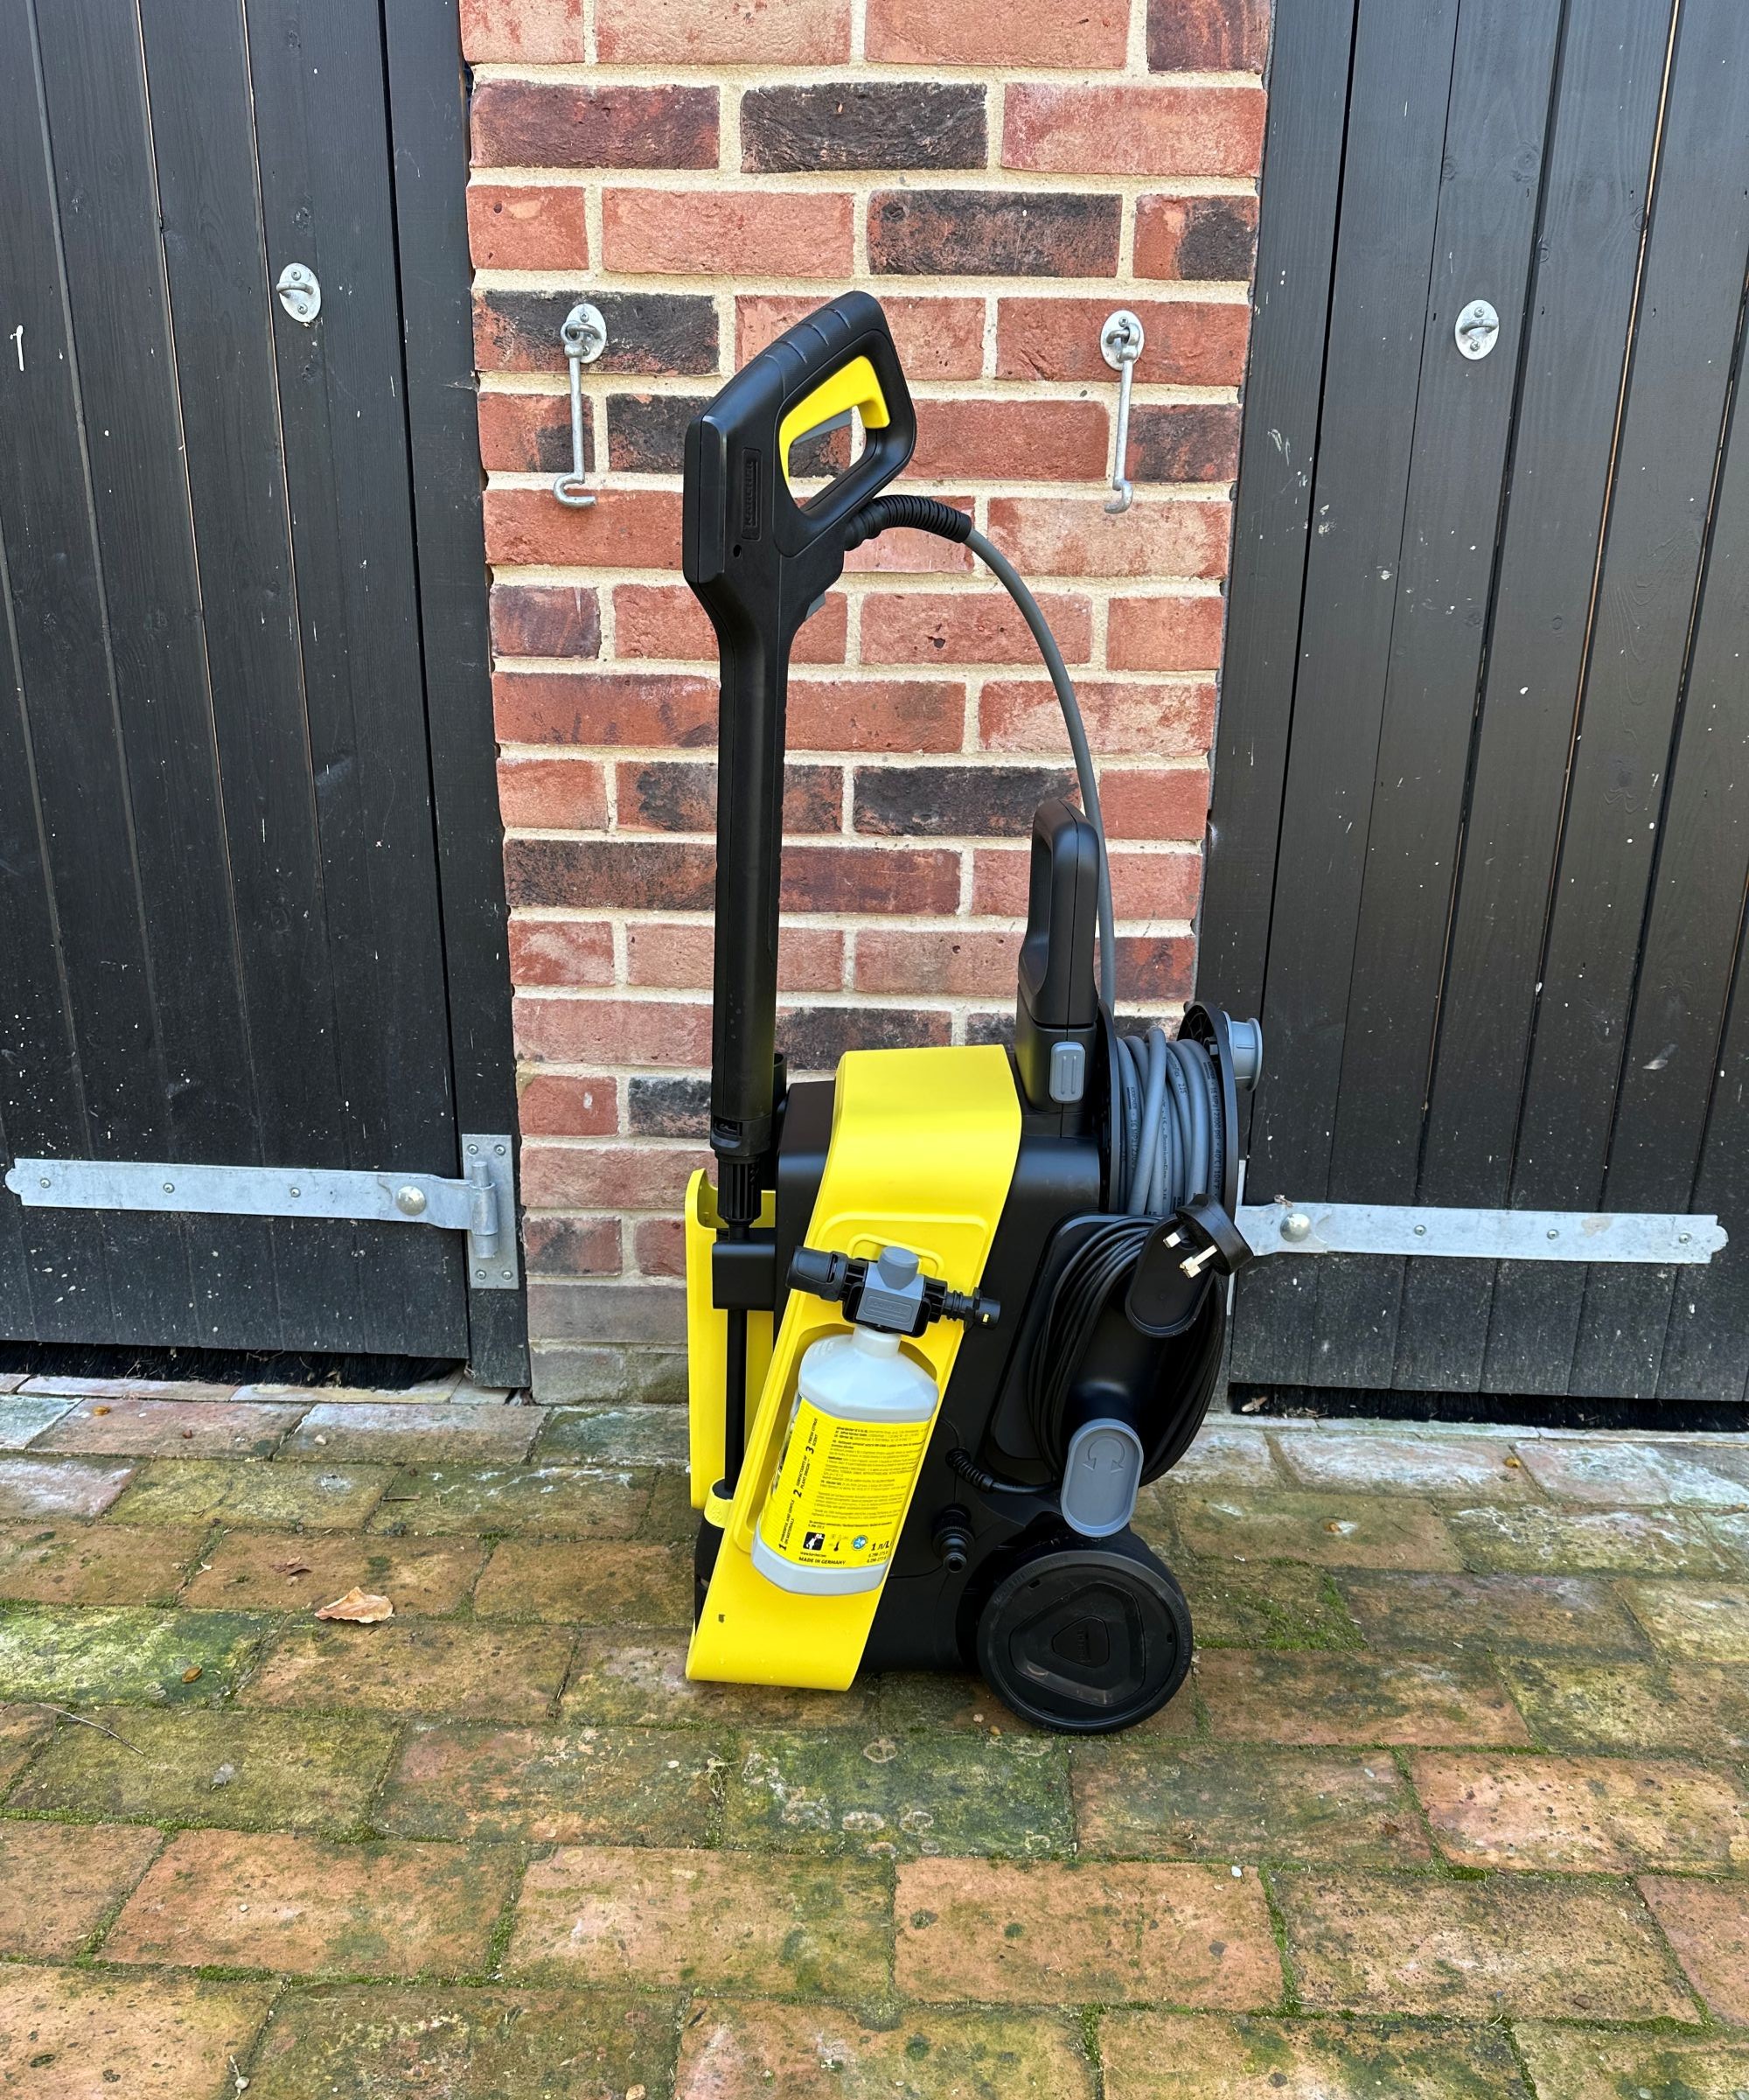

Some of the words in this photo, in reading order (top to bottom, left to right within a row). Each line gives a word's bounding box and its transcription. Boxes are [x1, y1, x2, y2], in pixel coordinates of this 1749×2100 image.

[1213, 1112, 1222, 1127] 2300
[793, 1489, 802, 1497] 2
[871, 1542, 877, 1551] 1
